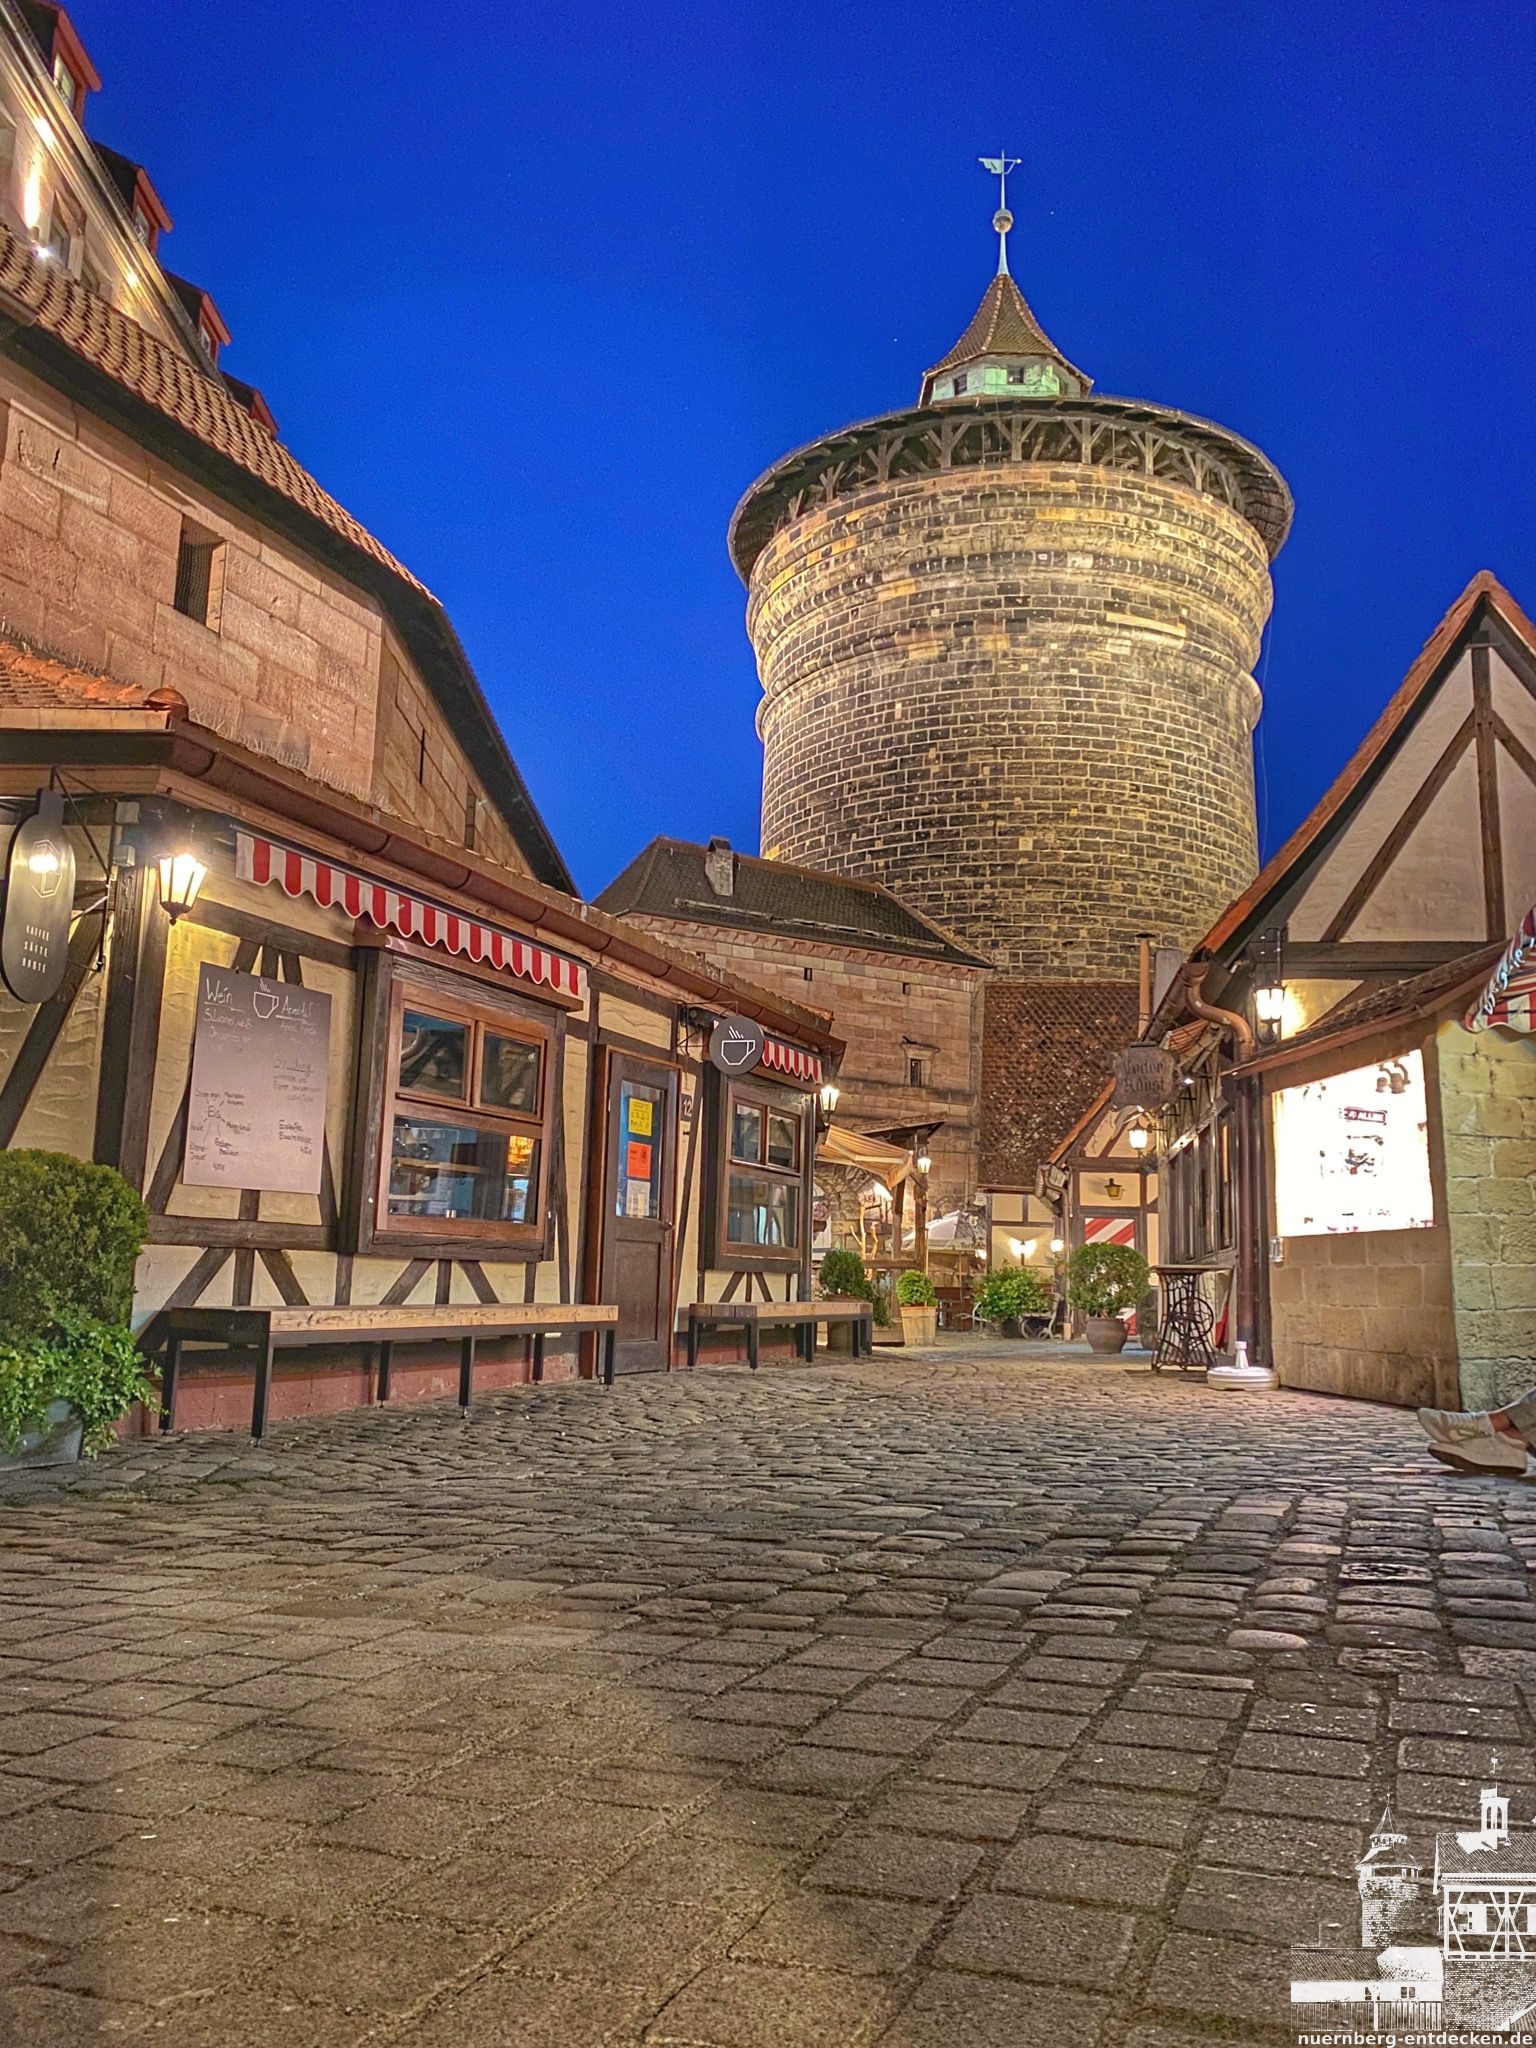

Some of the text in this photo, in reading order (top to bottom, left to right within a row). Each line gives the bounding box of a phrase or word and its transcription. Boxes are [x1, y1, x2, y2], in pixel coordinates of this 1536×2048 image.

[26, 924, 50, 942] KAFFEE
[23, 940, 49, 958] SÄFTE
[205, 977, 233, 1004] Wein
[683, 1099, 693, 1118] 12
